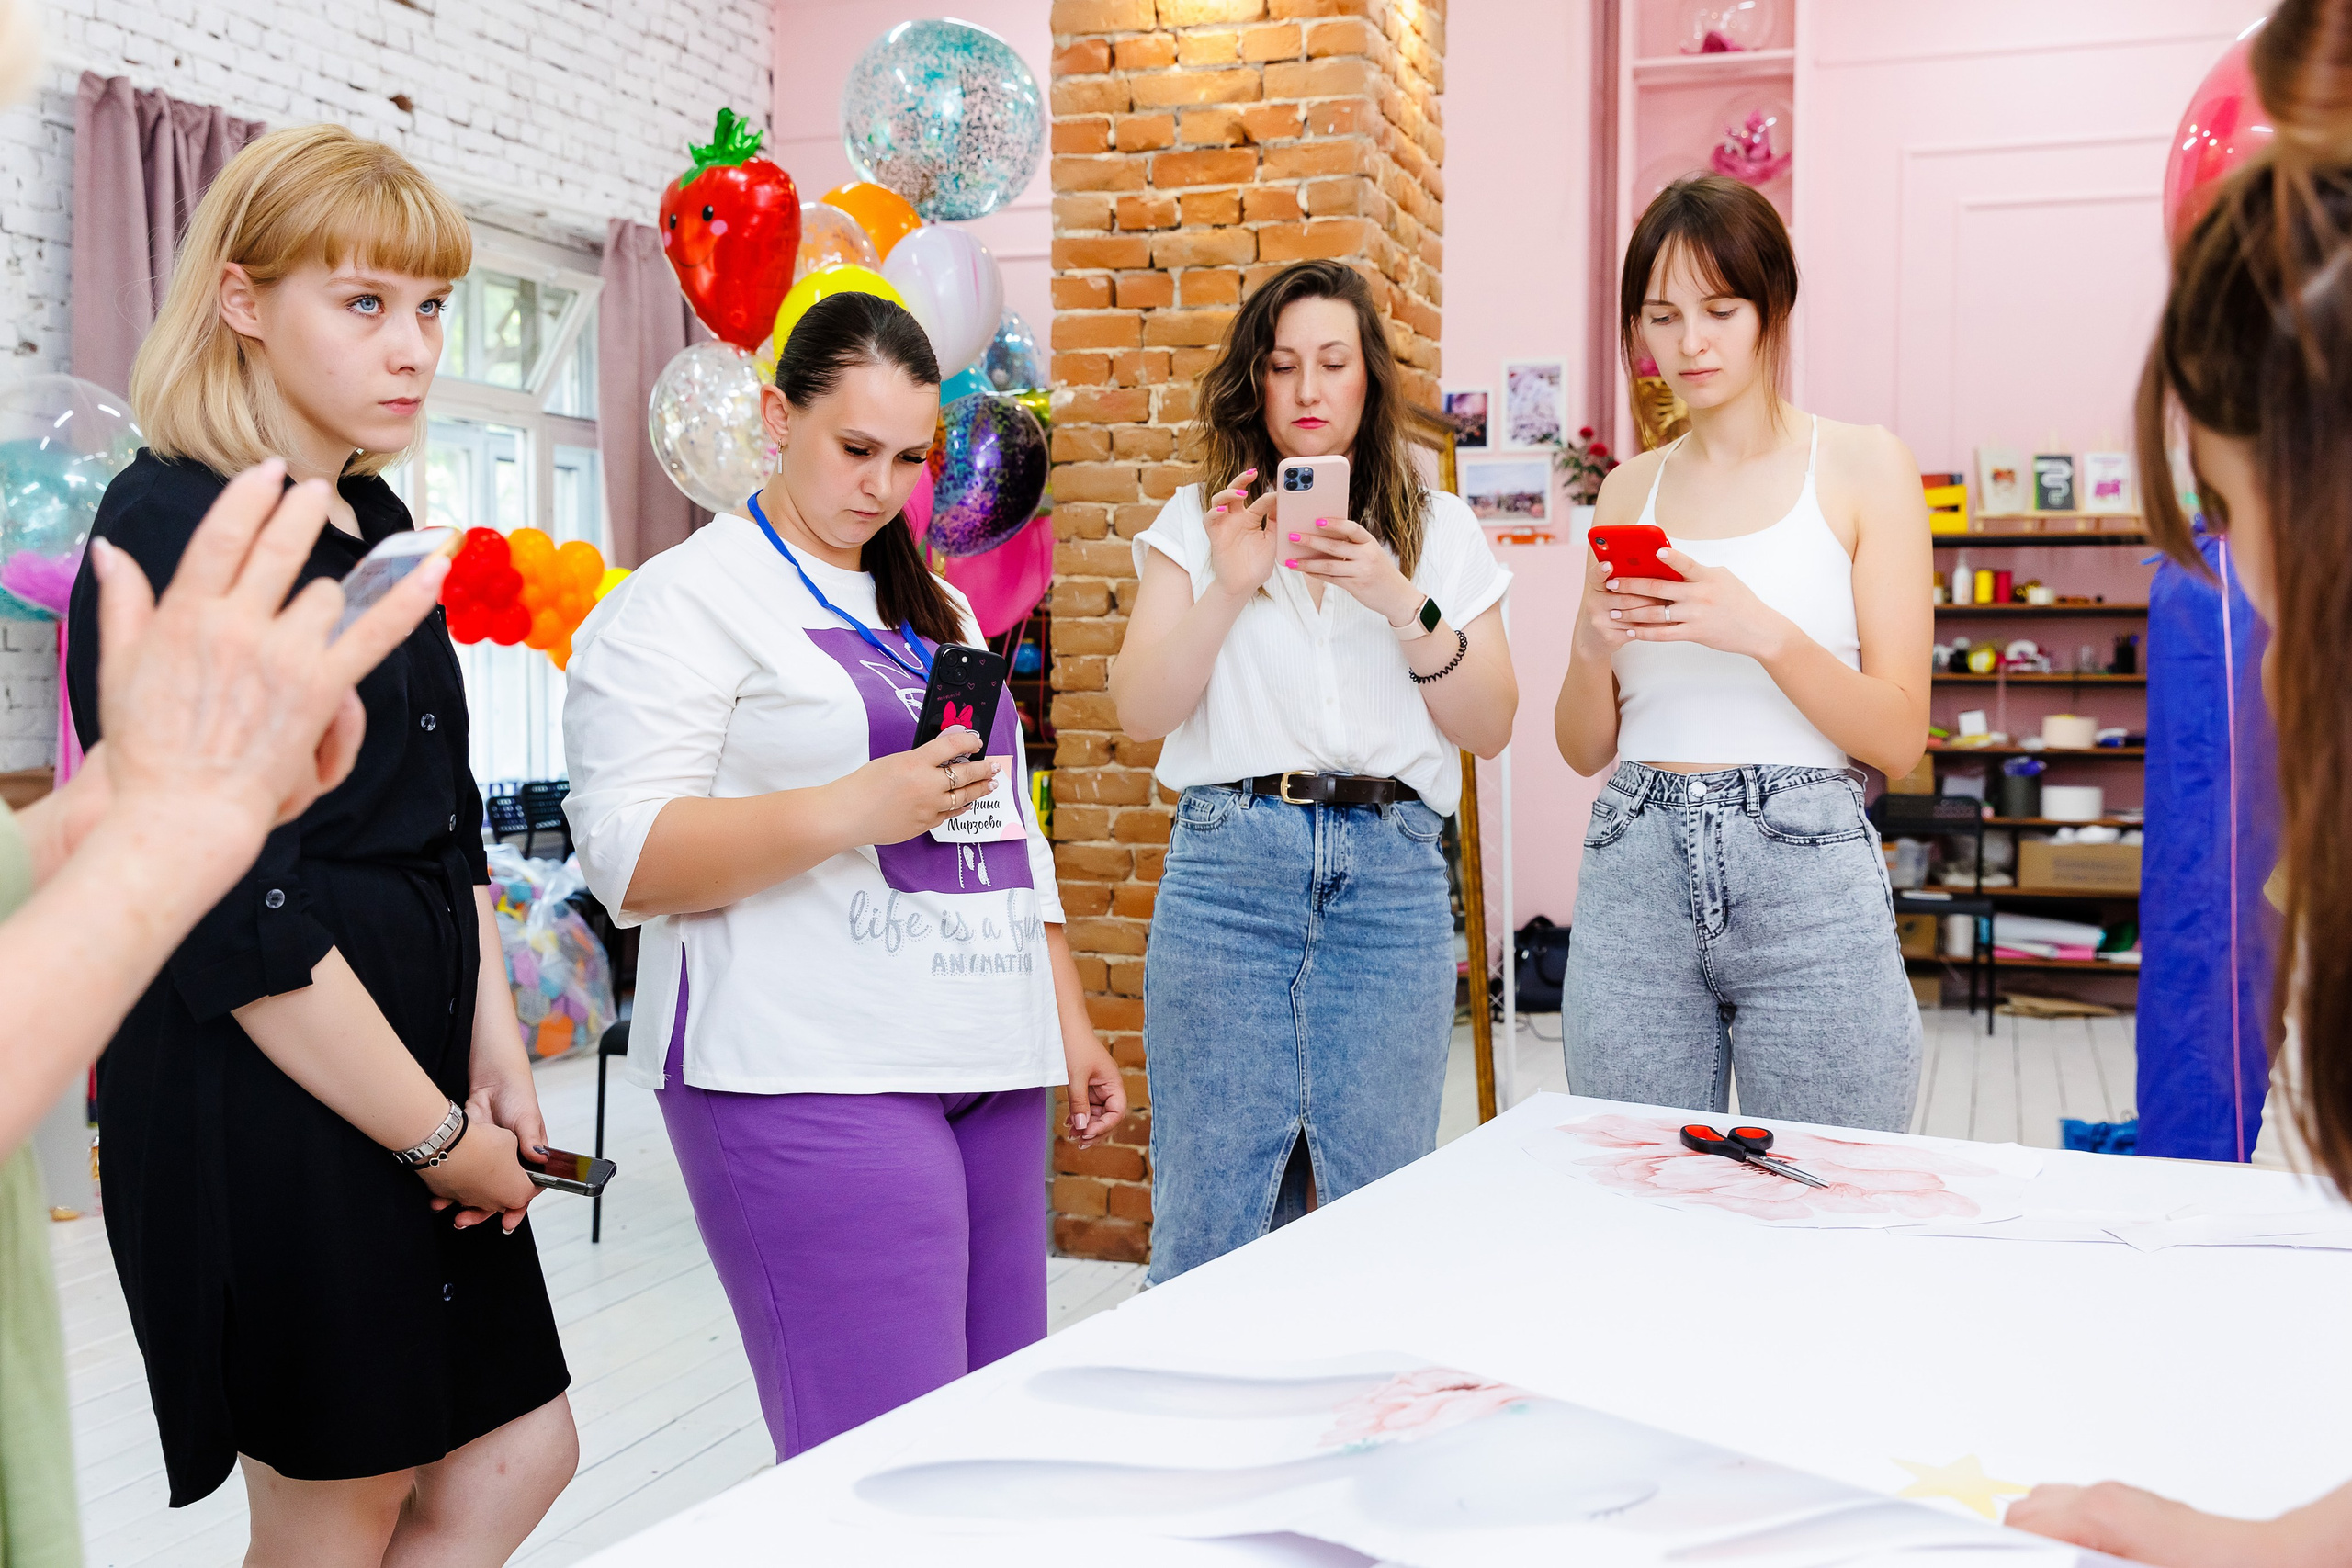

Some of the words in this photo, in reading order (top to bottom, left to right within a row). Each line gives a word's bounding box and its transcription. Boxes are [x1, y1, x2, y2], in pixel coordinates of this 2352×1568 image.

[947, 814, 1001, 834] Мирзоева
[849, 889, 931, 955] life
[940, 909, 975, 943] is
[982, 917, 1001, 941] a
